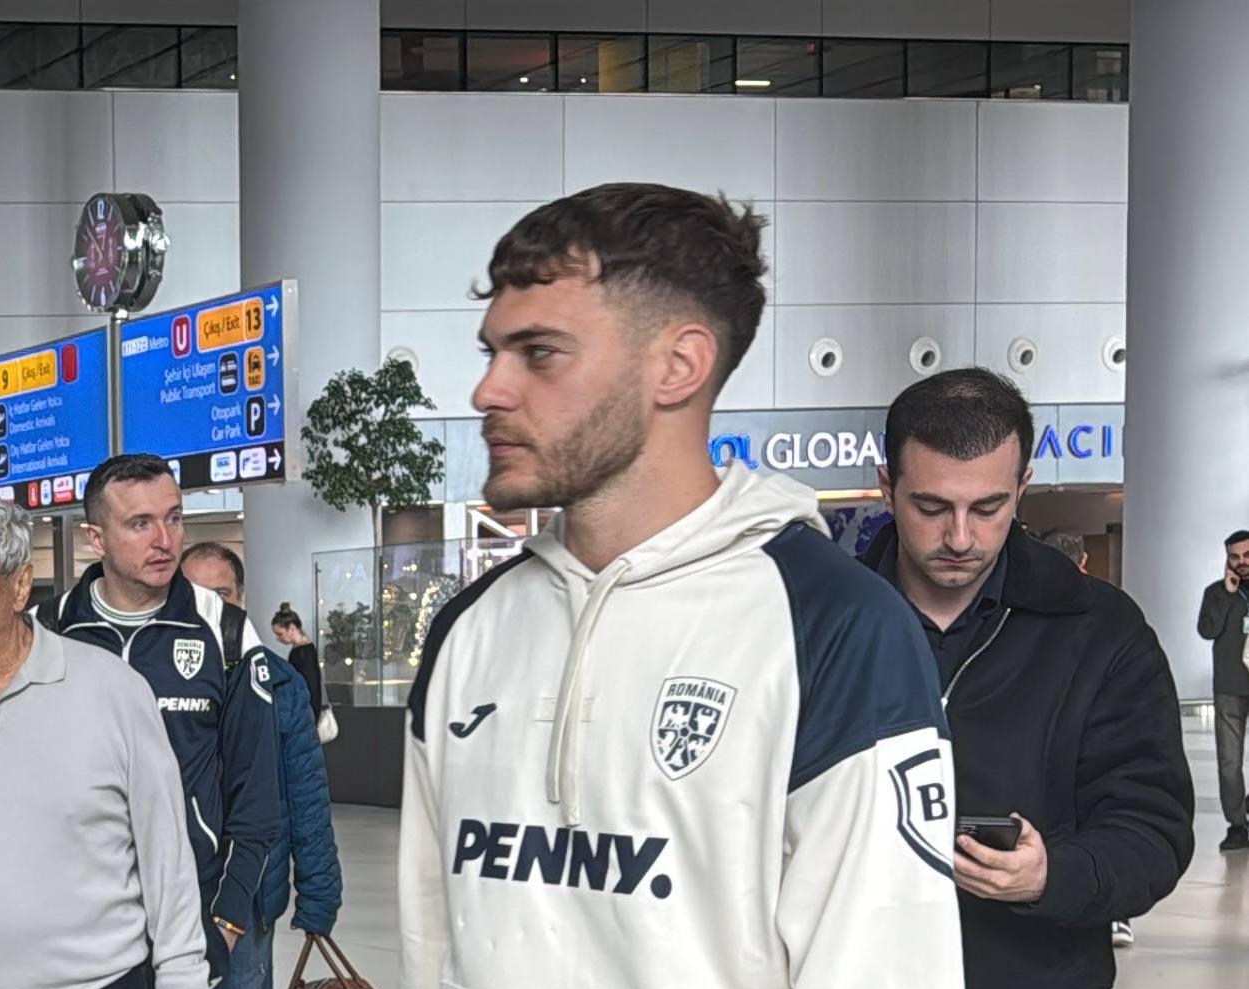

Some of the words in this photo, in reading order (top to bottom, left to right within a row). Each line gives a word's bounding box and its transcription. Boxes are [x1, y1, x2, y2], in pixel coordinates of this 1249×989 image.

[227, 315, 240, 331] Exit
[246, 307, 261, 331] 13
[2, 370, 8, 390] 9
[160, 388, 181, 403] Public
[182, 382, 215, 399] Transport
[212, 402, 241, 421] Otopark
[251, 403, 260, 431] P
[212, 427, 224, 441] Car
[225, 423, 241, 439] Park
[666, 682, 726, 706] ROMÂNIA
[452, 818, 672, 899] PENNY.
